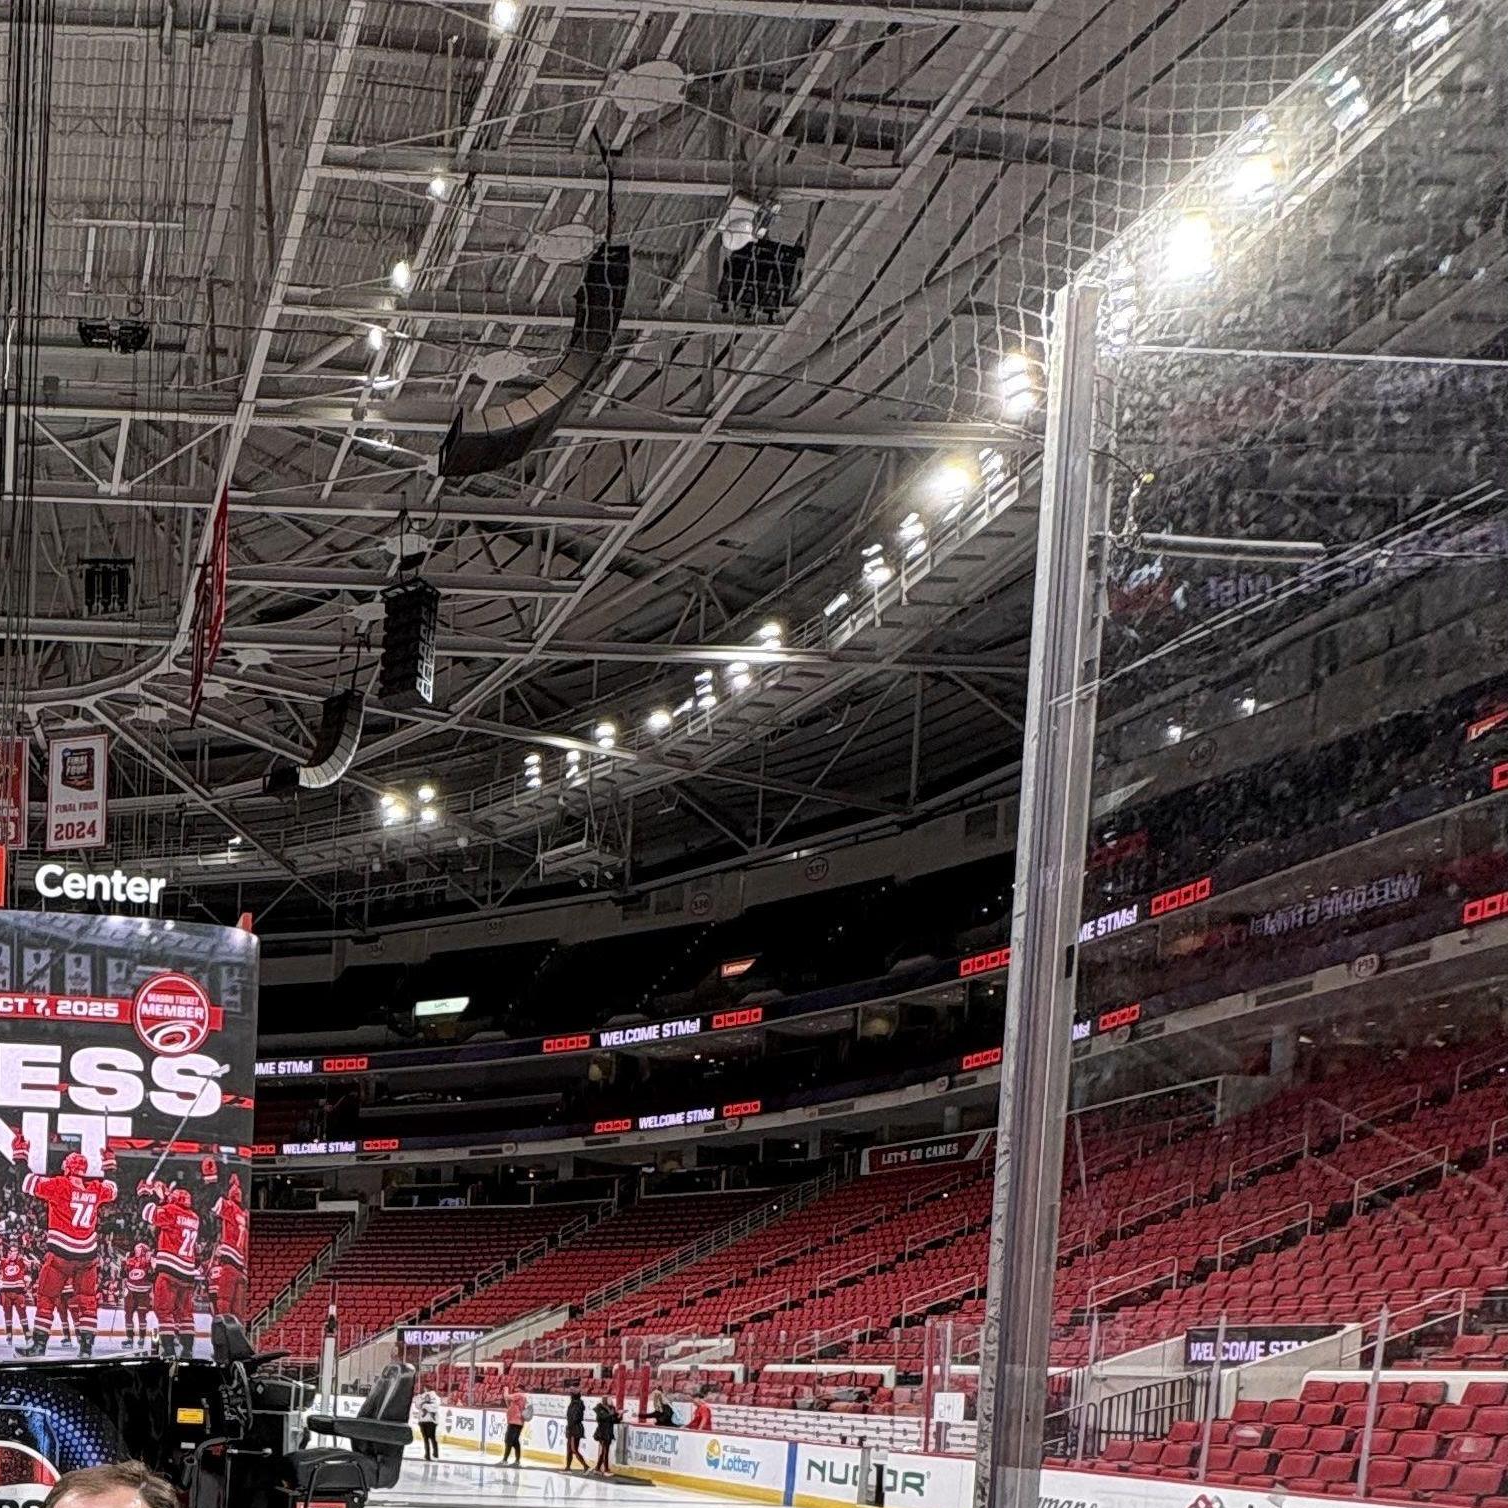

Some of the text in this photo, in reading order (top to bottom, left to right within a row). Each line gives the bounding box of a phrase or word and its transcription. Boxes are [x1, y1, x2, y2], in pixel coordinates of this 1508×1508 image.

[54, 820, 97, 842] 2024
[35, 863, 167, 904] Center
[1096, 903, 1139, 937] STMs!
[32, 998, 51, 1017] 7,
[56, 999, 119, 1018] 2025
[142, 1003, 205, 1020] MEMBER
[600, 1017, 701, 1048] WELCOME STMs!
[278, 1060, 313, 1074] STMs!
[639, 1111, 687, 1130] WELCOME
[282, 1142, 328, 1156] WELCOME
[925, 1142, 959, 1158] CANES
[69, 1202, 94, 1229] 74
[1190, 1340, 1309, 1362] WELCOME STM
[722, 1455, 761, 1479] Lottery
